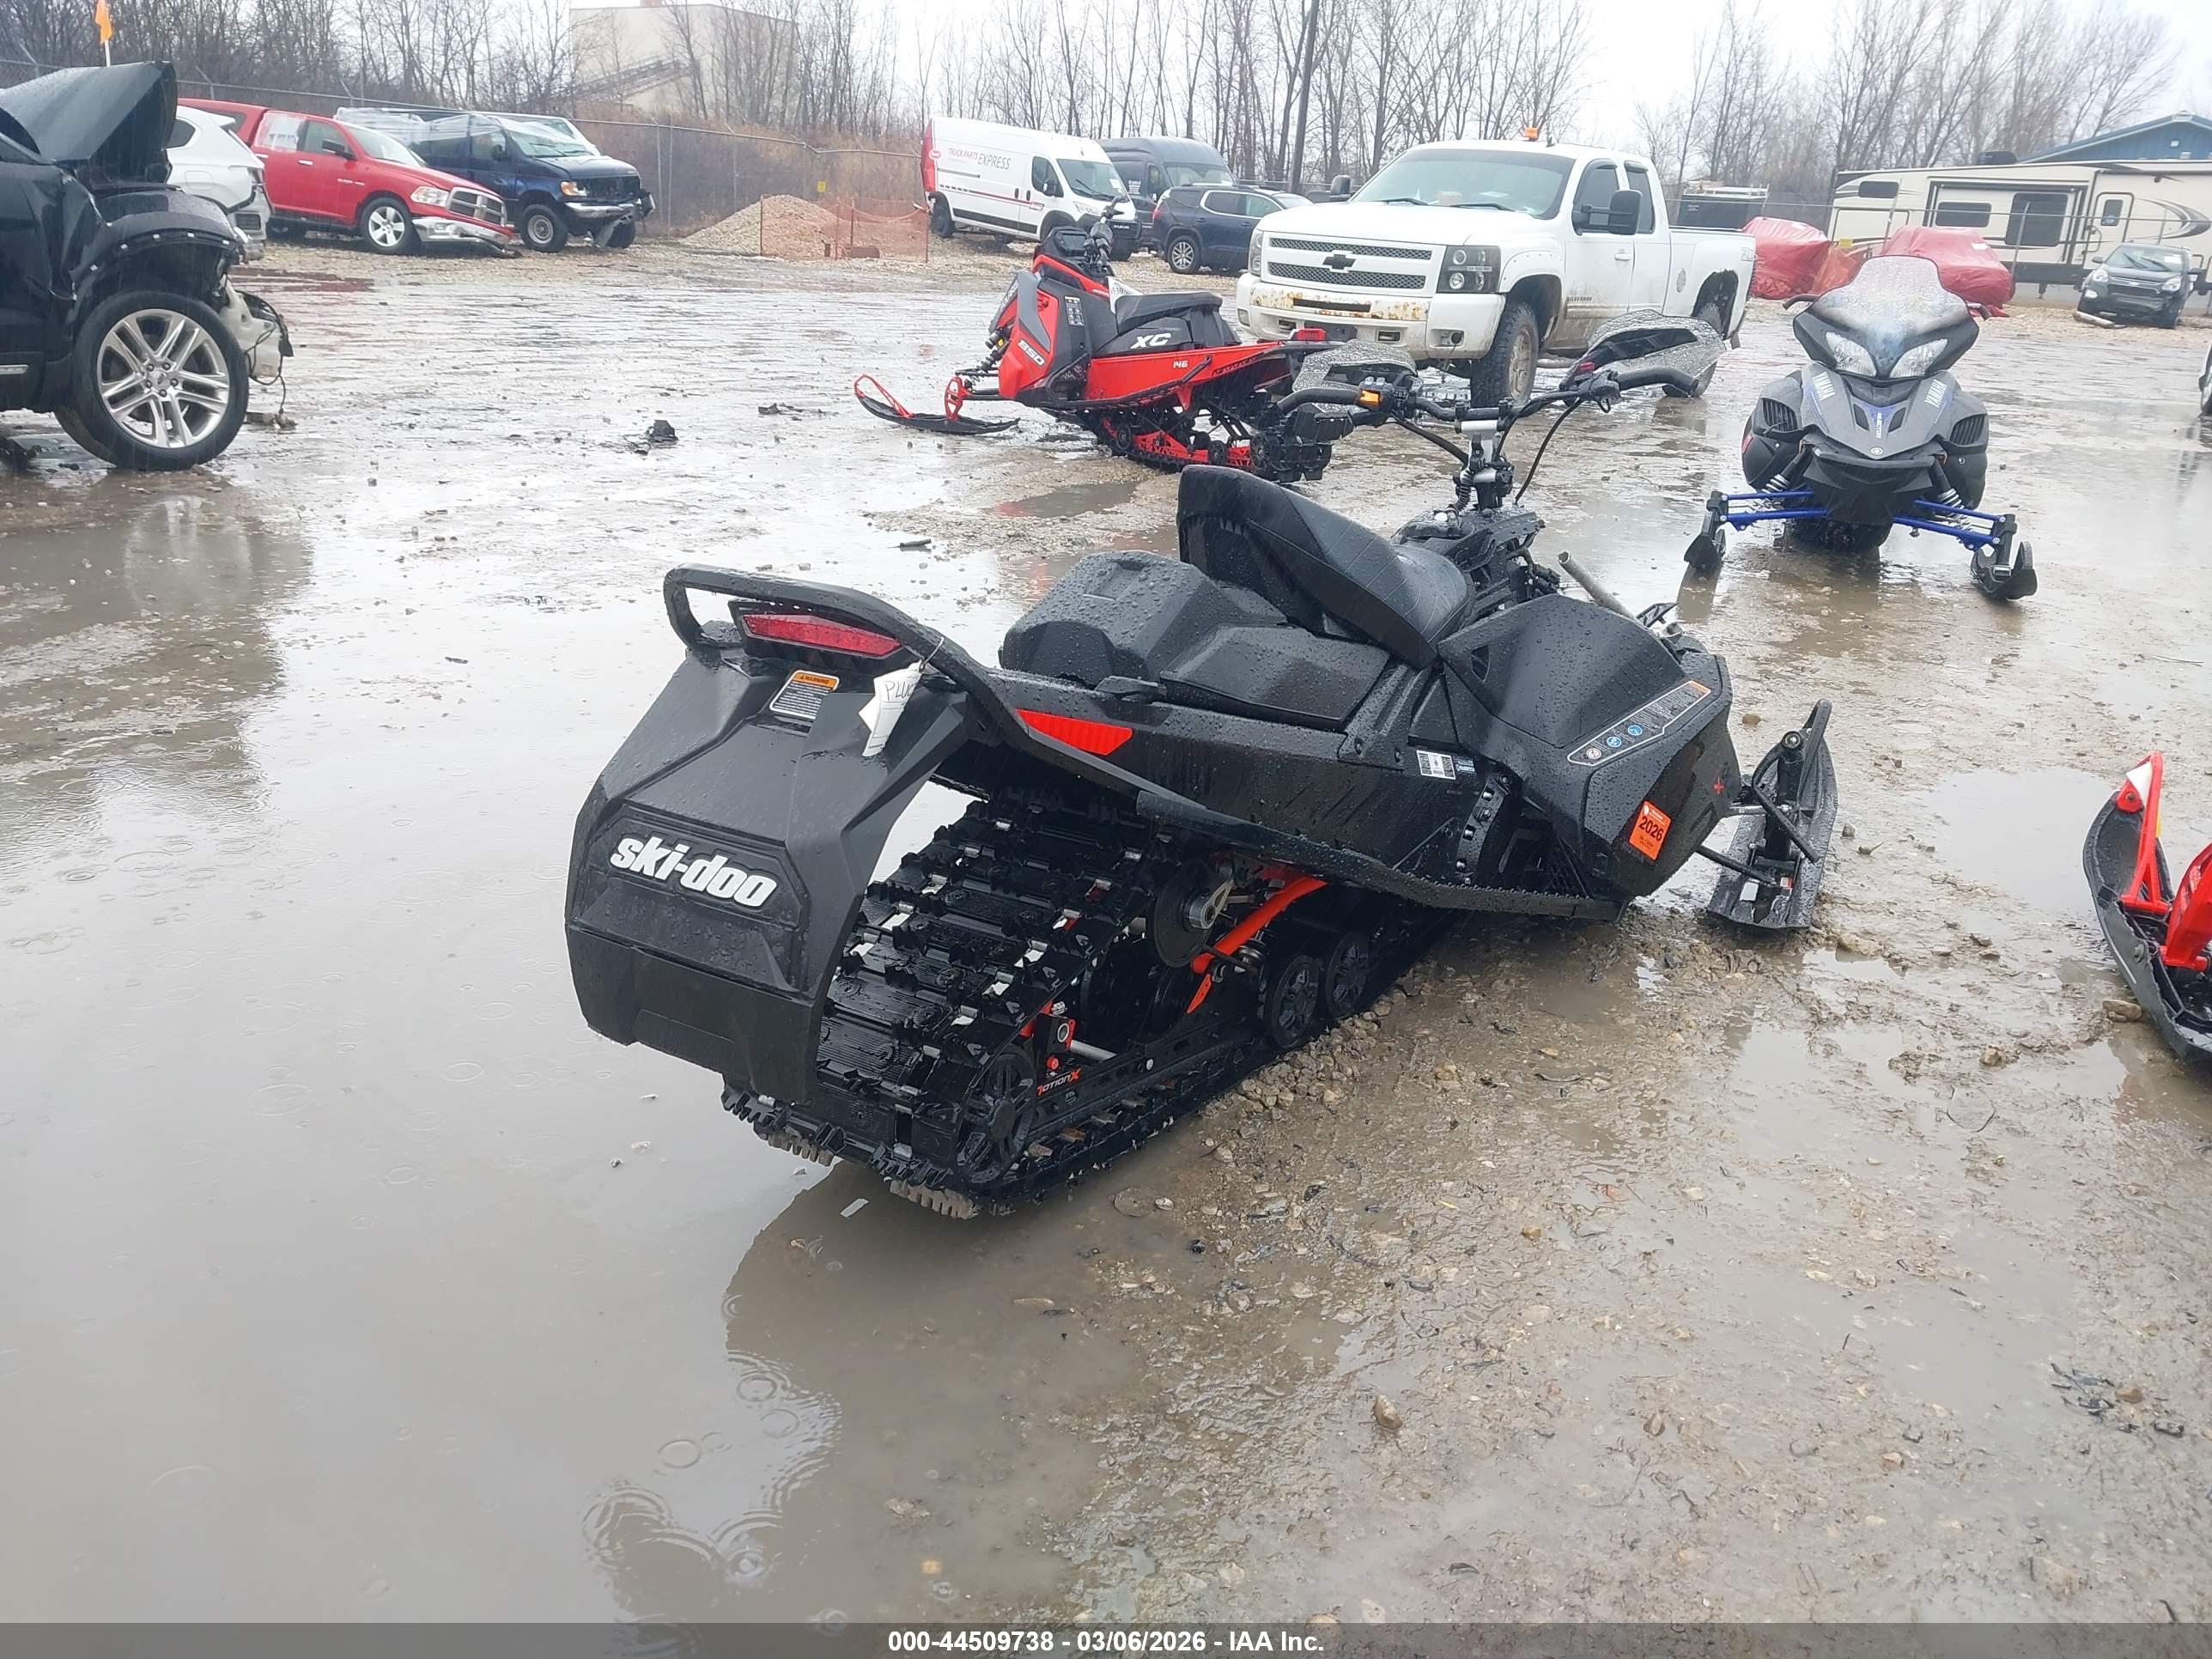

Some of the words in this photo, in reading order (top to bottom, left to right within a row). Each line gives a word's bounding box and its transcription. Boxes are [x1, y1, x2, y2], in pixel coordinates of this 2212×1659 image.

[978, 153, 1012, 170] EXPRESS
[1130, 332, 1171, 349] XC
[1173, 360, 1188, 368] 146
[1812, 371, 1836, 402] YAMAHA
[1923, 379, 1948, 409] YAMAHA
[1638, 816, 1664, 842] 2026
[609, 836, 778, 908] ski-doo
